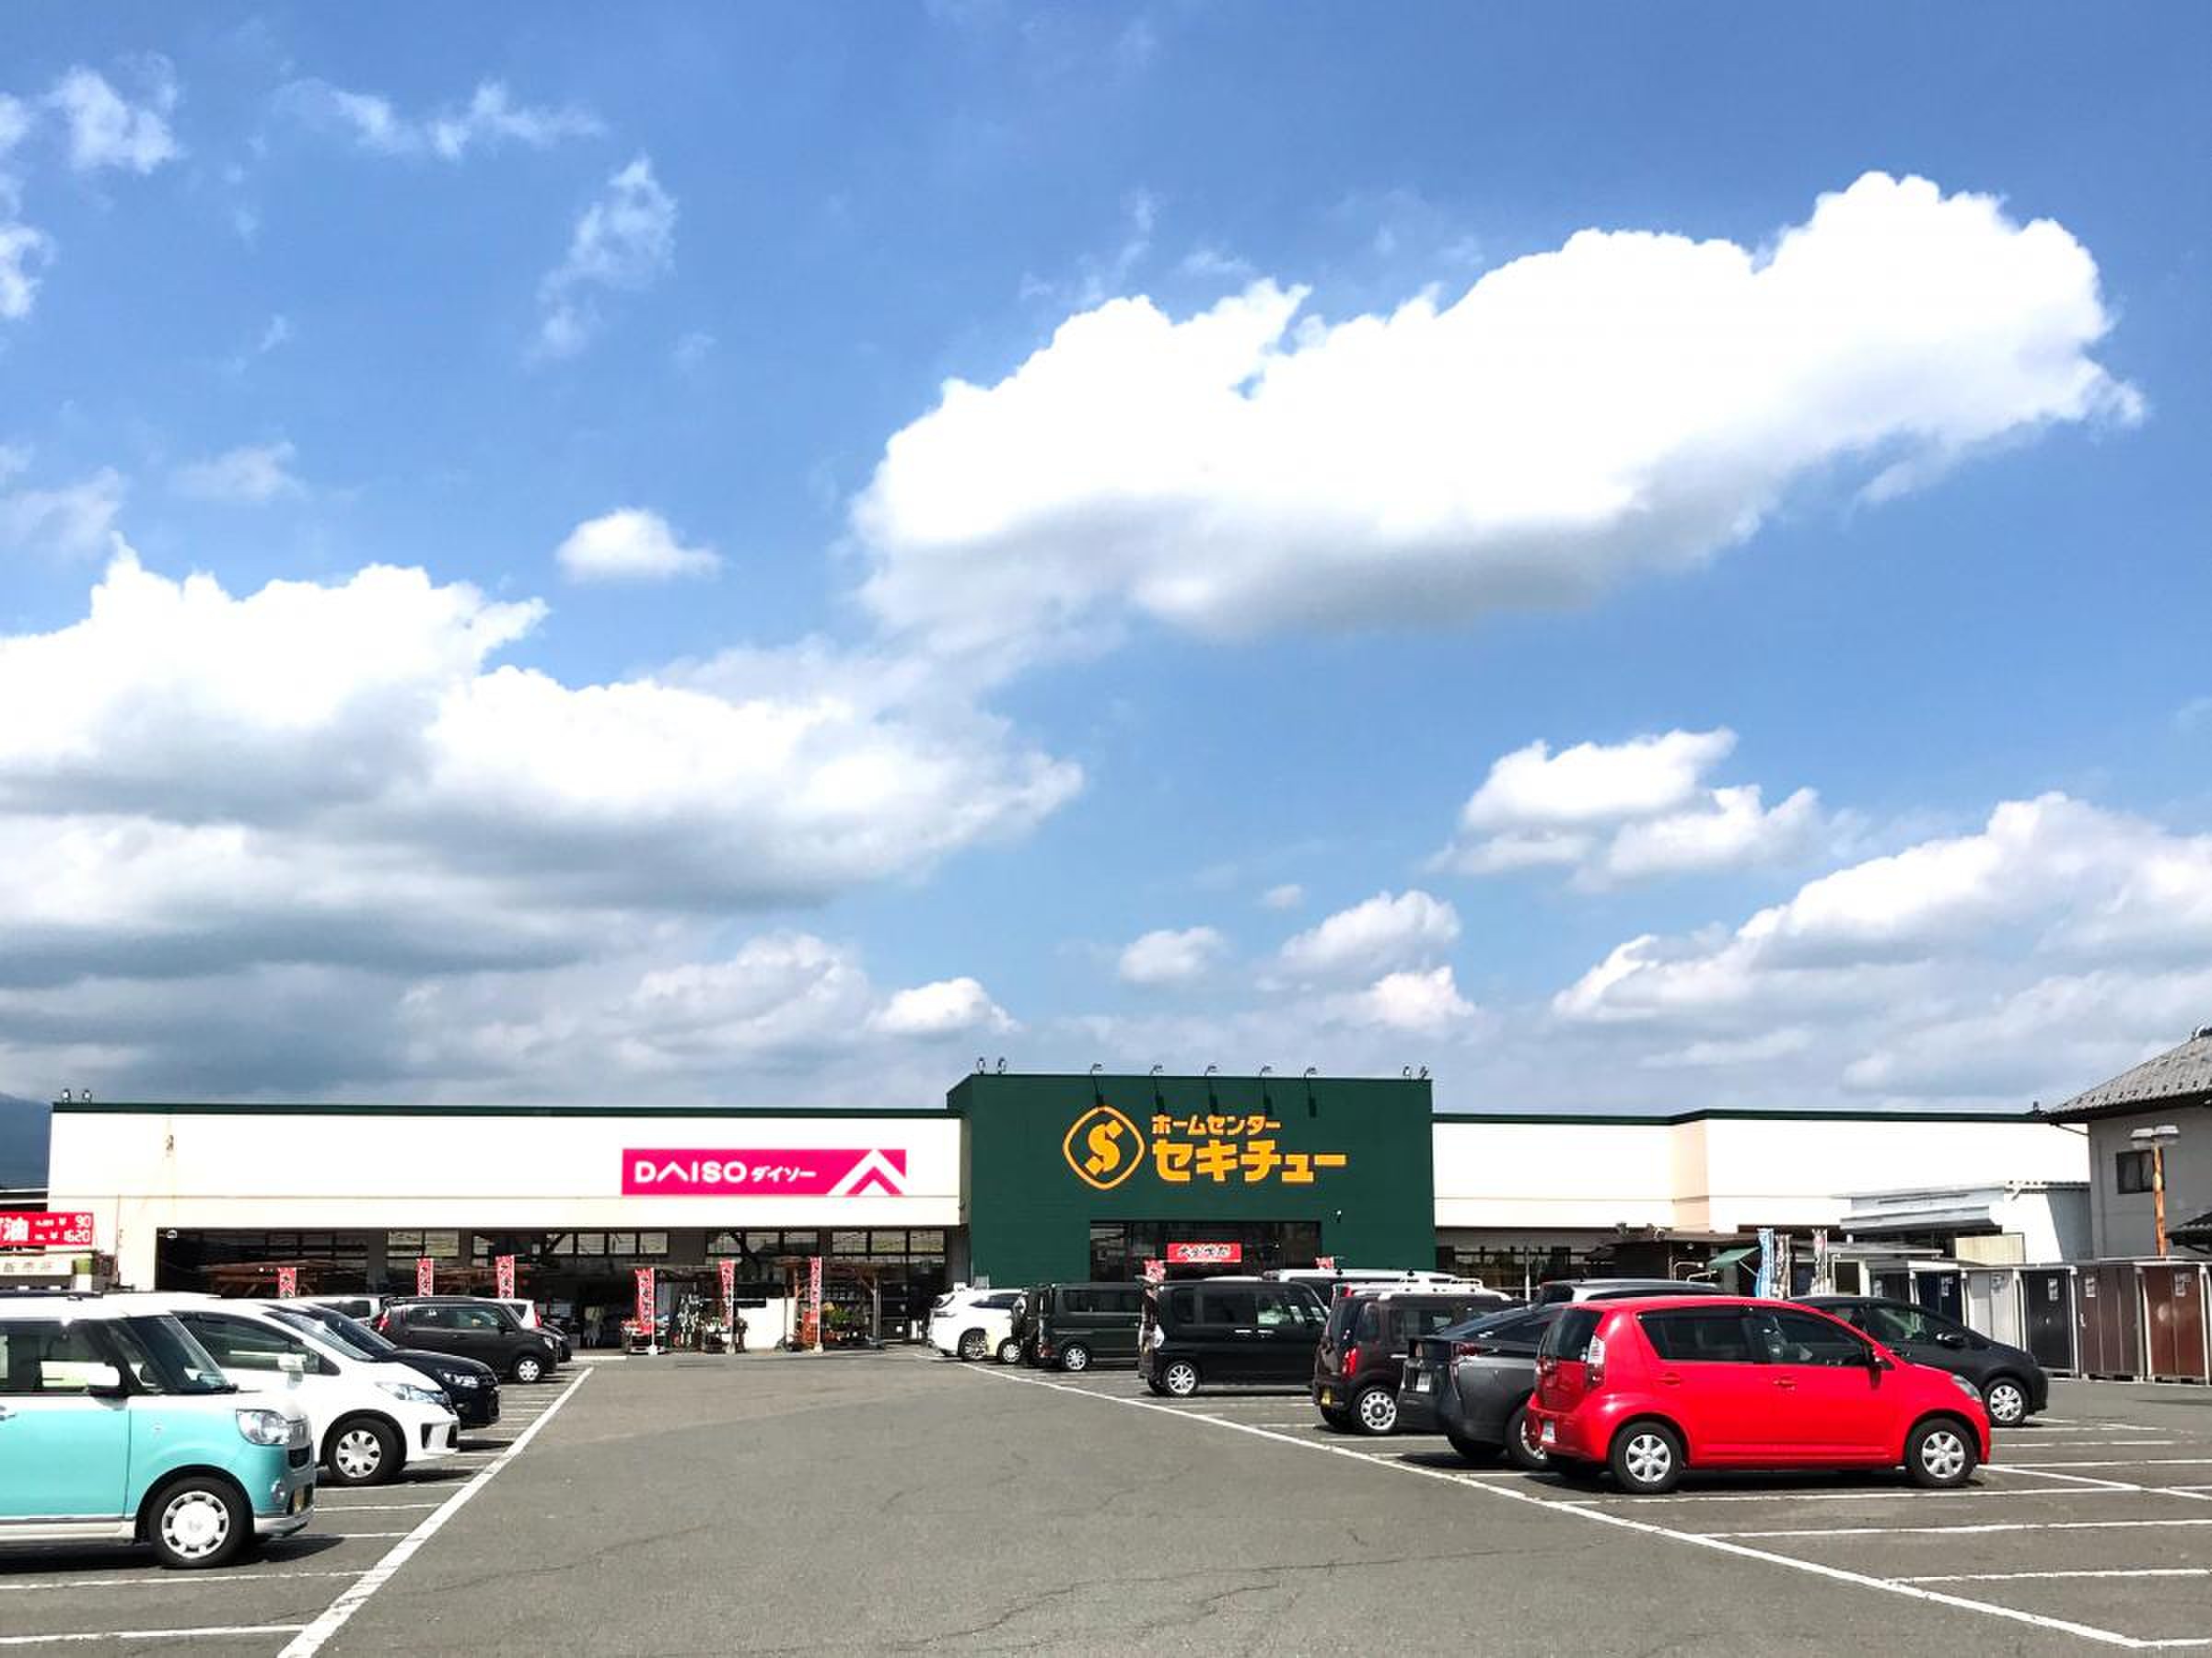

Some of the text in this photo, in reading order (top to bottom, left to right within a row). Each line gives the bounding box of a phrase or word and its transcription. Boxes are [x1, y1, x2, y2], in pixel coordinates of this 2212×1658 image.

[1152, 1115, 1281, 1135] ホームセンター
[1152, 1139, 1346, 1182] セキチュー
[634, 1161, 816, 1183] DAISO ダイソー
